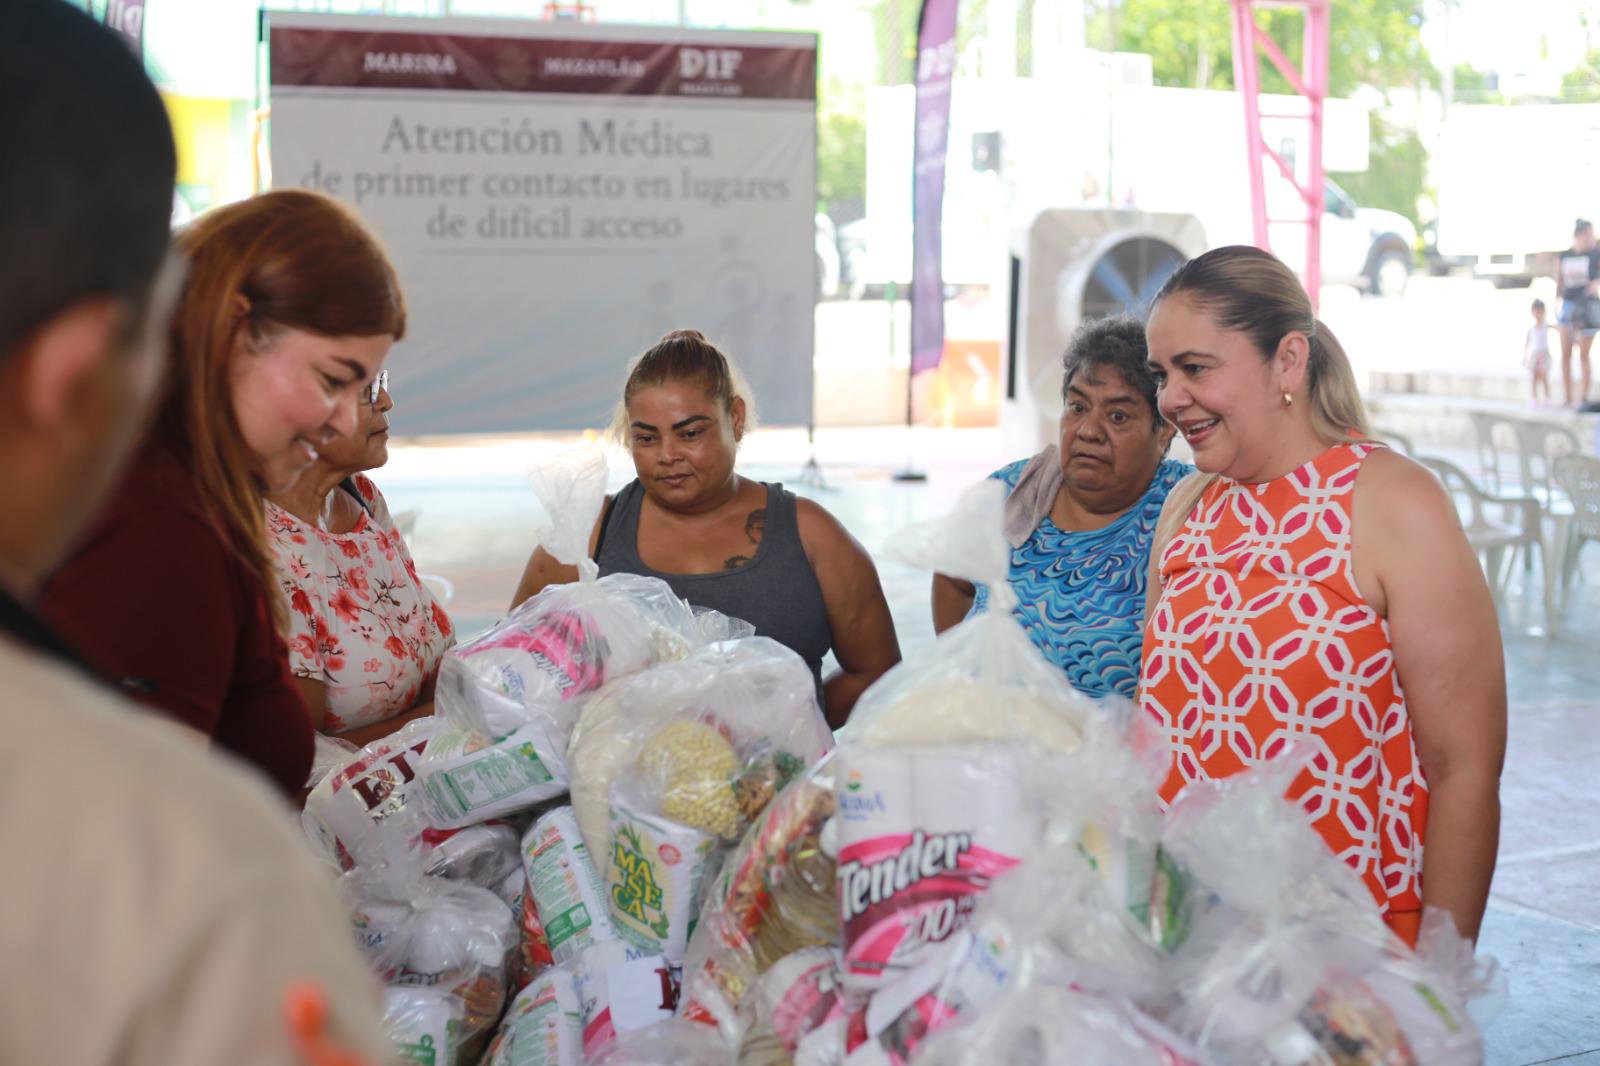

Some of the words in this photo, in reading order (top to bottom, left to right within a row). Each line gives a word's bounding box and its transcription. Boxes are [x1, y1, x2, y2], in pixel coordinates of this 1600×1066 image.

[363, 51, 457, 75] MARINA
[679, 48, 743, 79] DIF
[382, 115, 562, 155] Atención
[578, 118, 713, 159] Médica
[301, 160, 342, 193] de
[354, 163, 474, 206] primer
[482, 171, 626, 199] contacto
[634, 175, 672, 199] en
[680, 167, 790, 209] lugares
[426, 203, 467, 239] de
[582, 216, 684, 241] acceso
[837, 829, 971, 922] Tender
